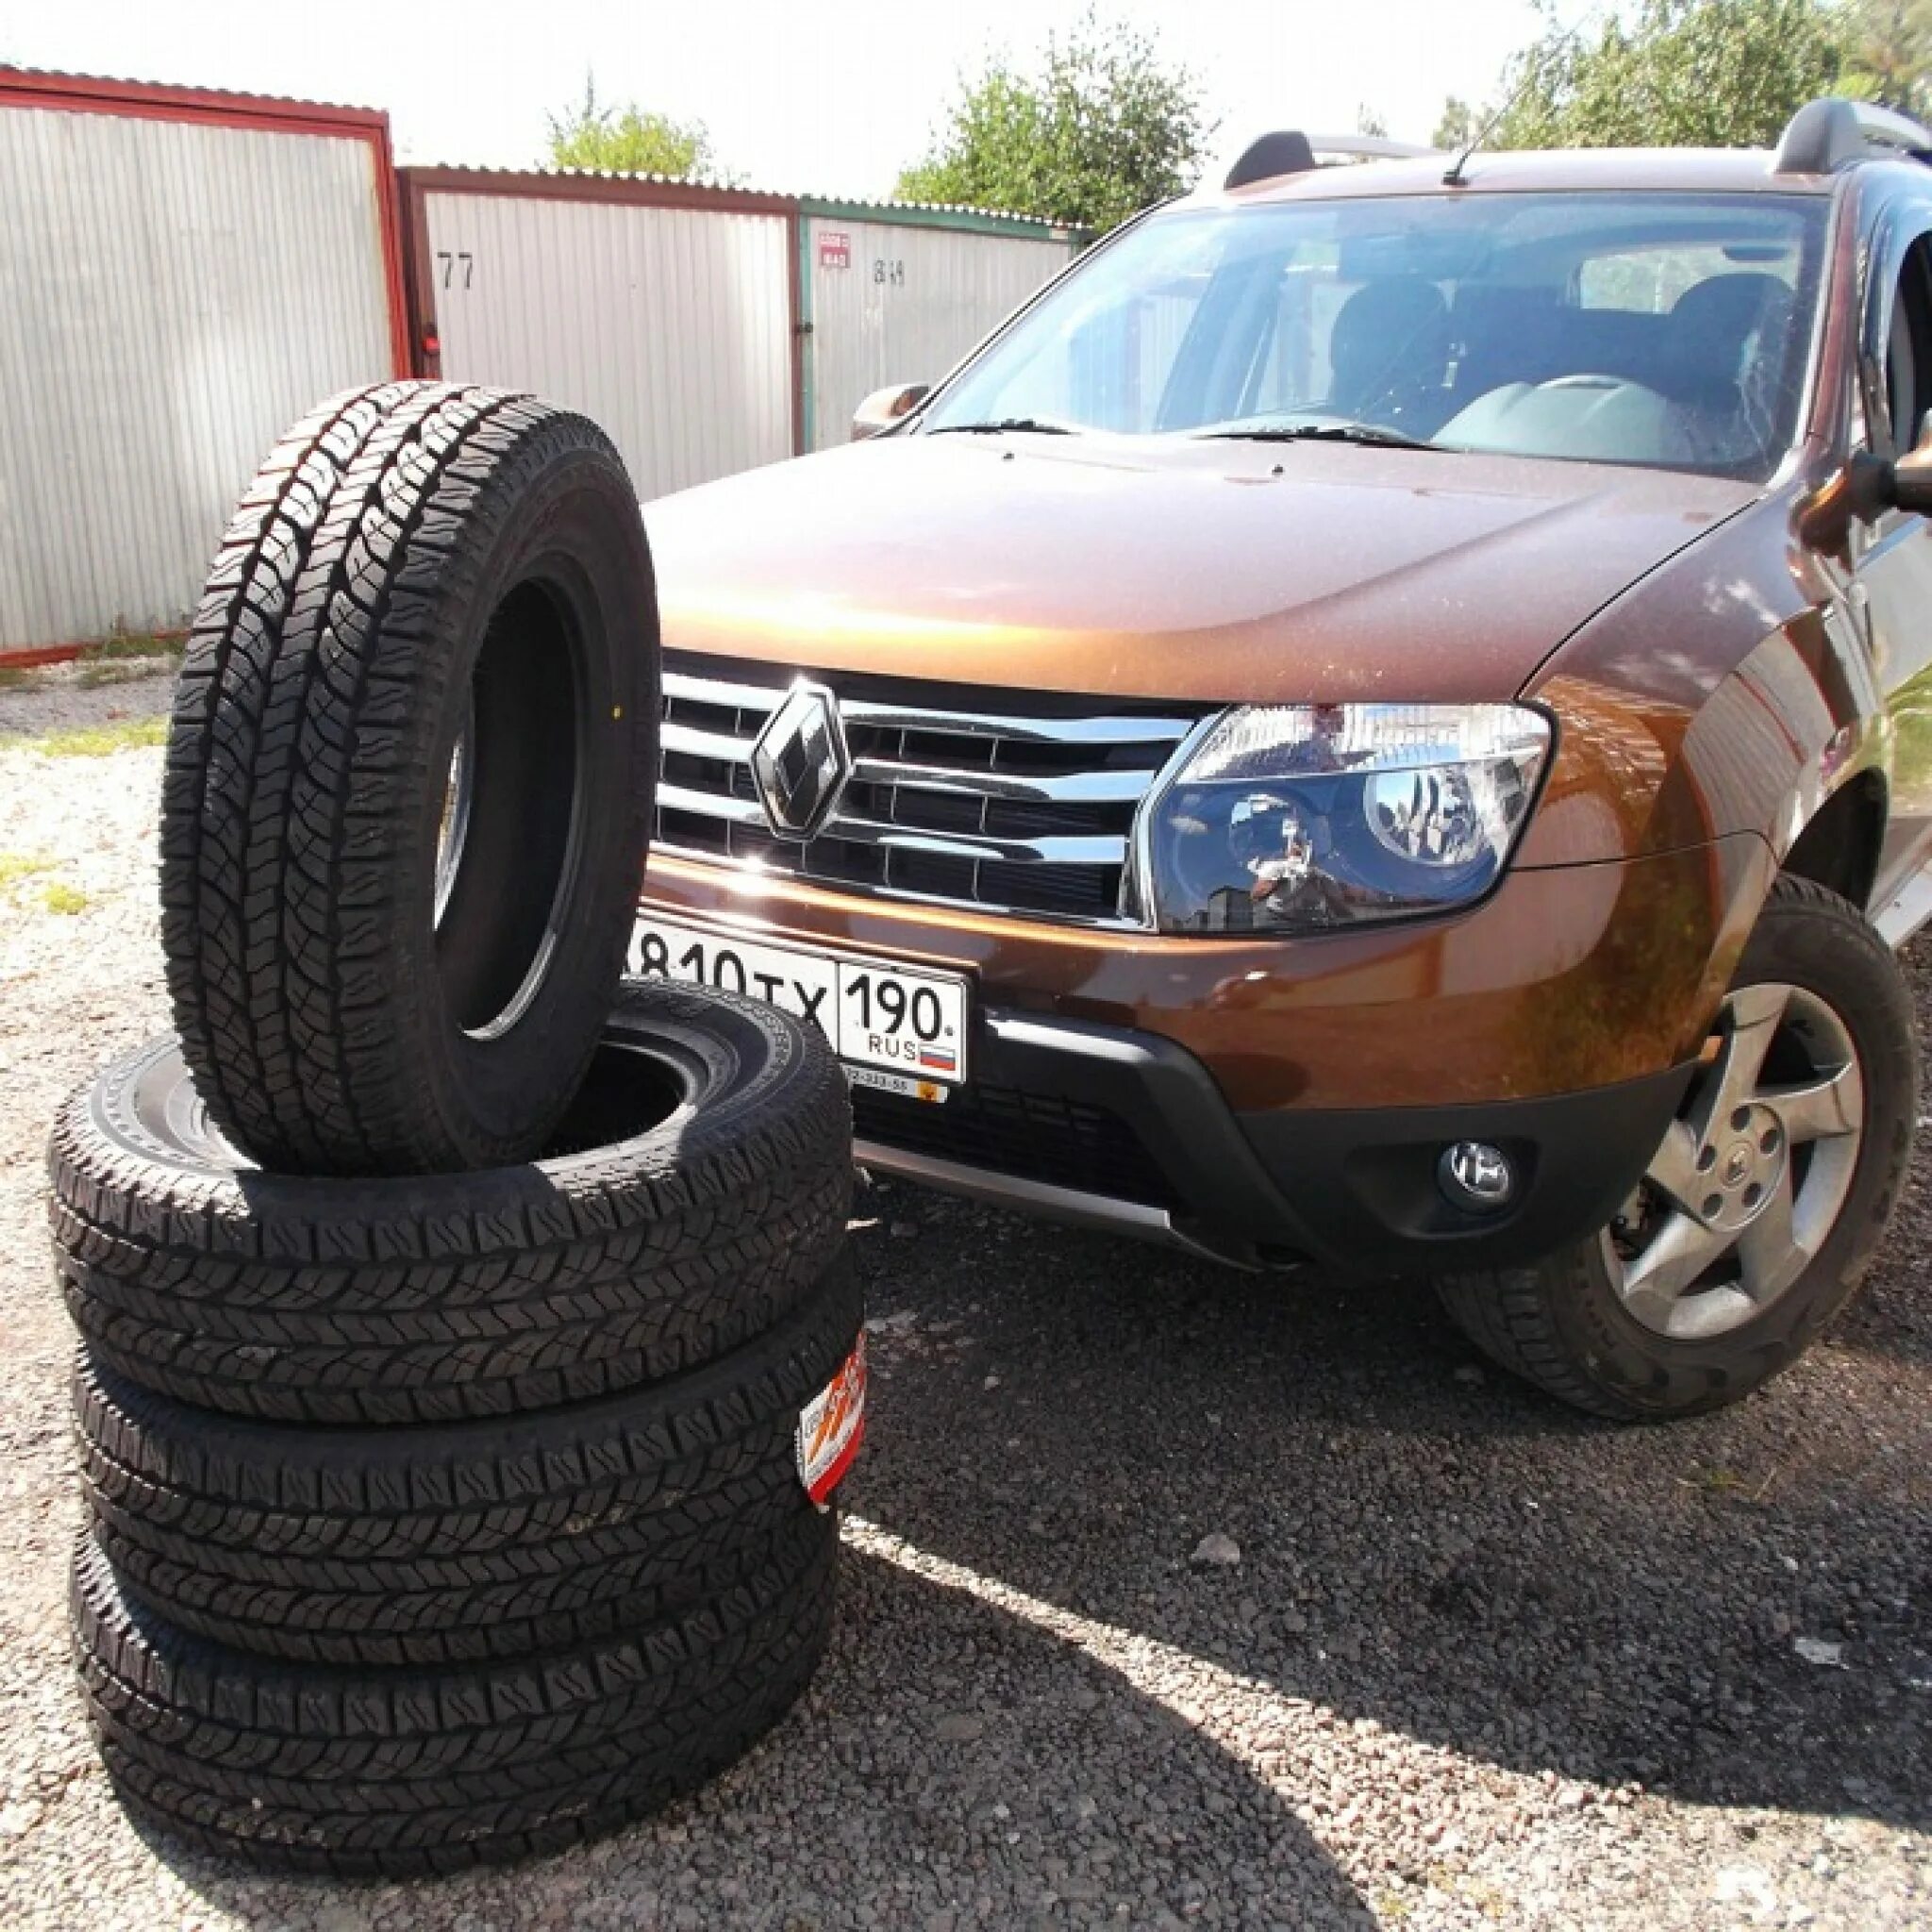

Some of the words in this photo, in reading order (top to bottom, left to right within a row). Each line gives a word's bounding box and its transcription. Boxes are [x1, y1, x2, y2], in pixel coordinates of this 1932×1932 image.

[437, 251, 474, 290] 77
[625, 931, 827, 1035] 810TX
[845, 974, 941, 1041] 190
[868, 1033, 917, 1060] RUS
